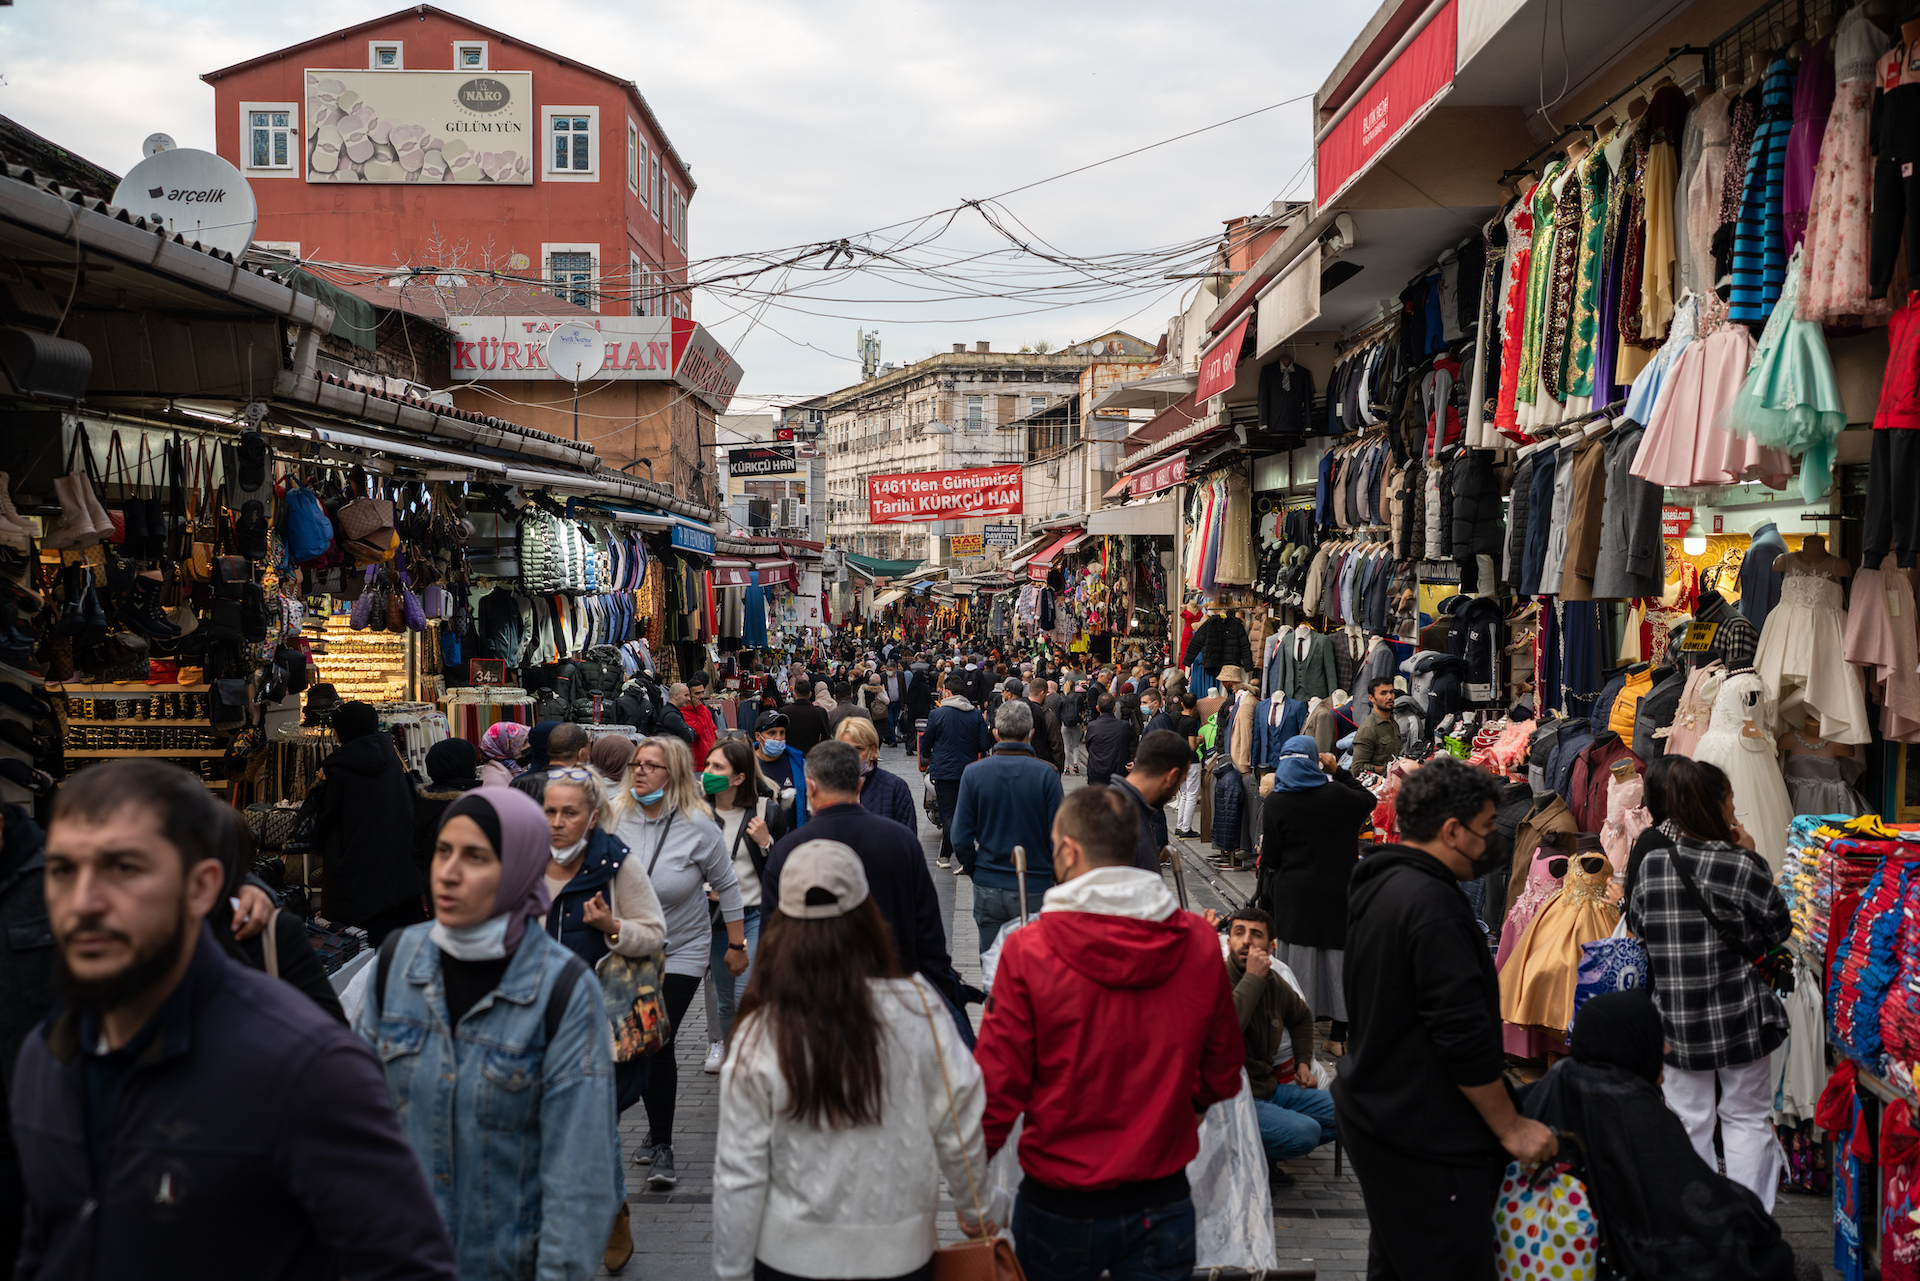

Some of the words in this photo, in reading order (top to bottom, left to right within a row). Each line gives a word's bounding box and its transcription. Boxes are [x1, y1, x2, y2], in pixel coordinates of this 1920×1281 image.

[465, 91, 503, 101] NAKO
[445, 120, 492, 133] GÜLÜM
[496, 121, 522, 133] YÜN
[167, 189, 226, 205] arçelik
[600, 341, 669, 371] HAN
[681, 345, 727, 399] KÜRKÇÜ
[730, 459, 772, 474] KÜRKÇÜ
[772, 459, 796, 471] HAN
[872, 478, 938, 495] 1461'den
[942, 472, 1018, 490] Günümüze
[872, 496, 915, 514] Tarihi
[919, 490, 984, 512] KÜRKÇÜ
[988, 489, 1020, 506] HAN
[952, 537, 981, 545] HAC
[1693, 623, 1713, 631] WOOL
